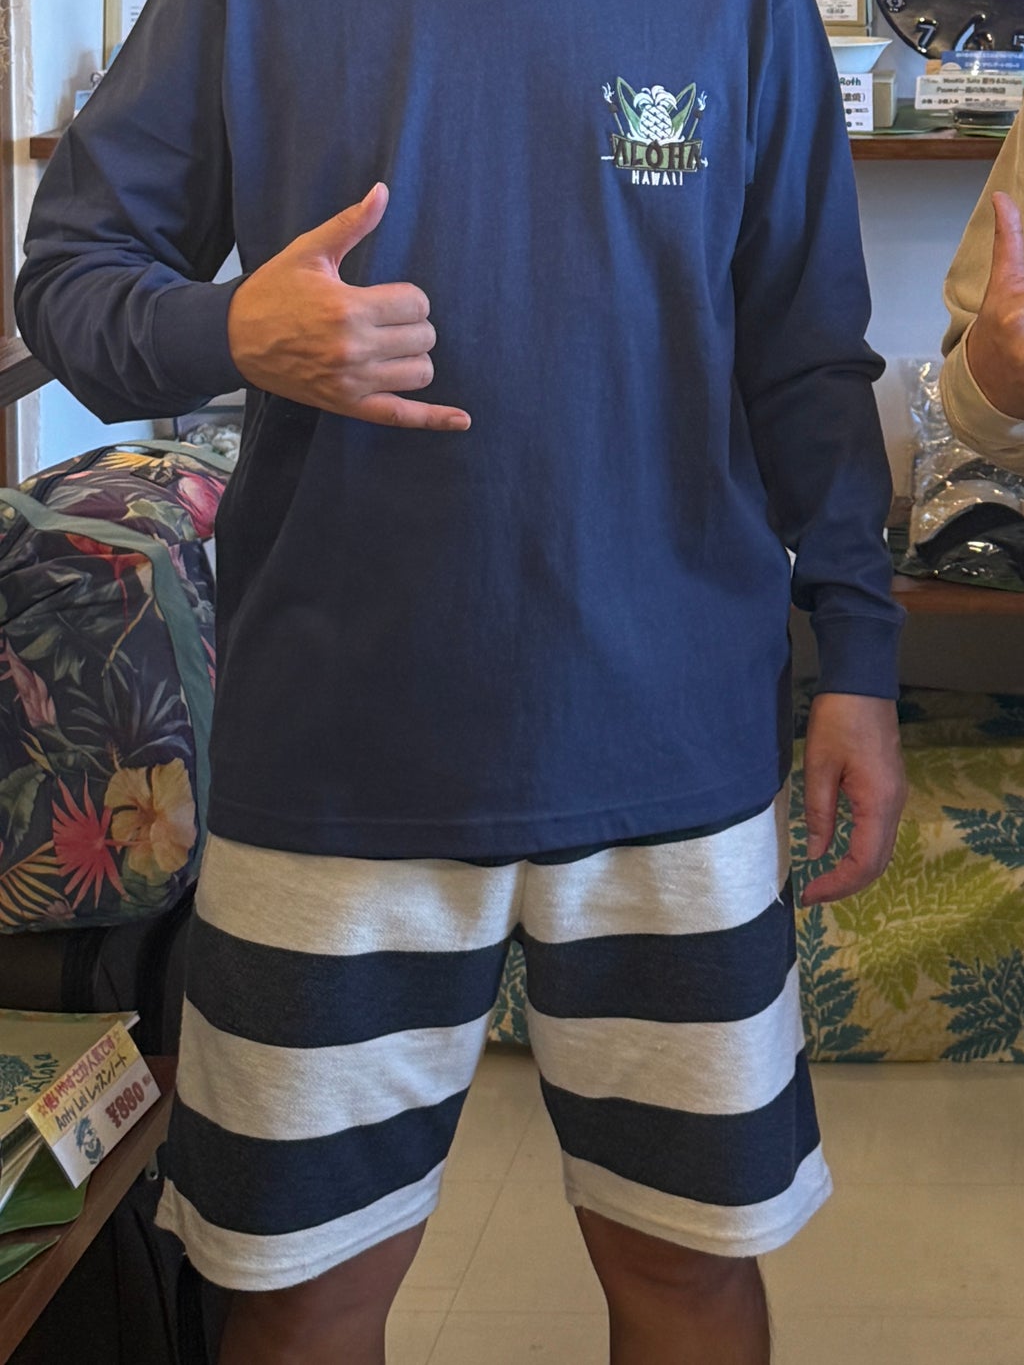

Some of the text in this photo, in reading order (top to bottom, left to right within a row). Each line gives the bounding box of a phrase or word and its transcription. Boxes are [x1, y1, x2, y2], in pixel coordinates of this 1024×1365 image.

[918, 23, 937, 52] 7
[613, 141, 701, 170] ALOHA
[632, 170, 684, 186] HAWAII
[105, 1081, 145, 1129] ¥880
